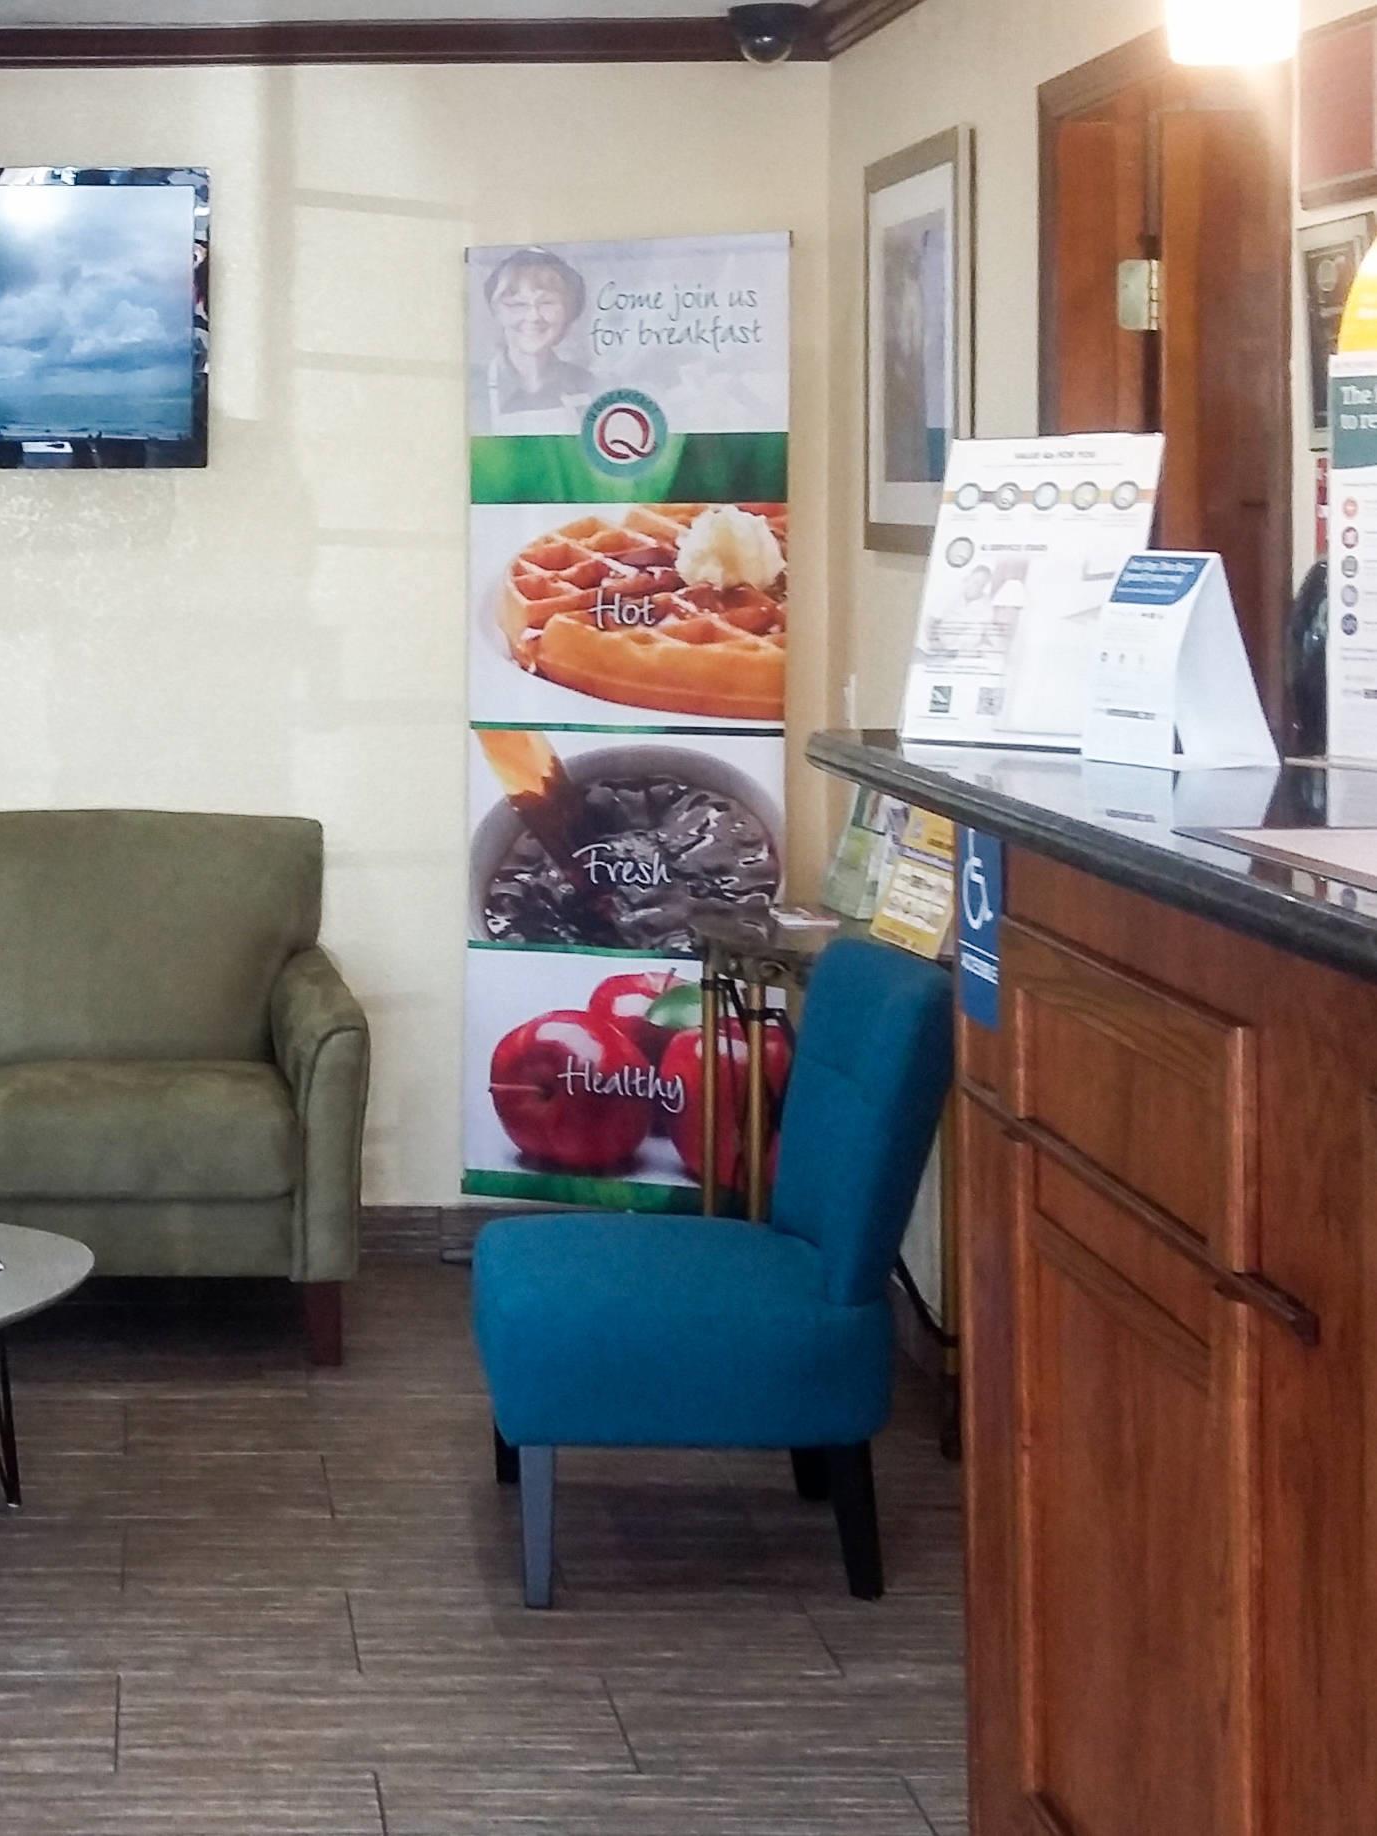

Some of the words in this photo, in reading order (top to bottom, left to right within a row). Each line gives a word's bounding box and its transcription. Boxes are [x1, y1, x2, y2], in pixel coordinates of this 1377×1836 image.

[596, 281, 664, 311] Come
[667, 284, 719, 321] join
[728, 288, 758, 309] us
[589, 318, 631, 356] for
[638, 316, 763, 354] breakfast
[590, 588, 657, 629] Hot
[572, 843, 671, 885] Fresh
[557, 1055, 685, 1114] Healthy
